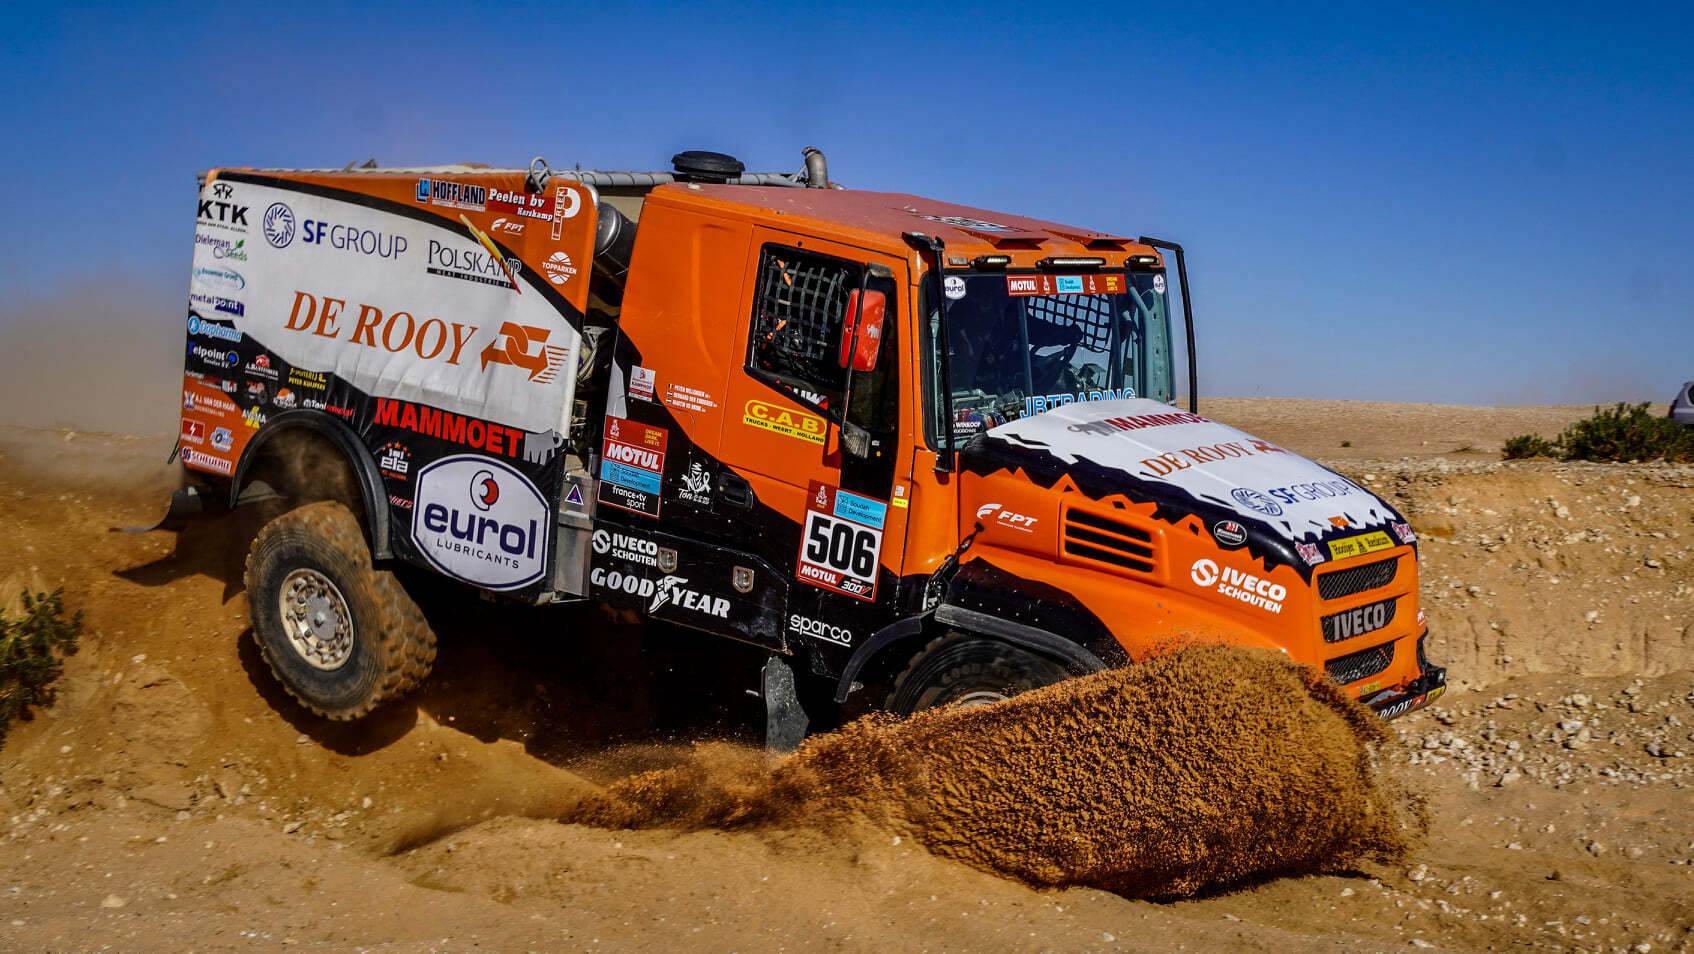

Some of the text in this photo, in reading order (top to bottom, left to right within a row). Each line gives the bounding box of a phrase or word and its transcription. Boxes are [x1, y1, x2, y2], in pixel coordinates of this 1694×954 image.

[432, 180, 486, 205] HOFFLAND
[488, 188, 525, 205] Peelen
[530, 194, 545, 208] bv
[198, 199, 249, 226] KTK
[504, 222, 525, 232] FPT
[542, 260, 577, 275] TOPPARKEN
[1010, 280, 1037, 291] MOTUL
[284, 291, 478, 366] DE ROOY
[374, 397, 524, 458] MAMMOET
[745, 417, 825, 443] TRUCKS WEERT HOLLAND
[606, 442, 660, 470] MOTUL
[1139, 441, 1255, 477] DE ROOY
[626, 498, 646, 510] sport
[848, 508, 882, 523] Development
[849, 500, 870, 511] Soudah
[998, 510, 1039, 527] FPT
[424, 503, 537, 560] eurol
[437, 538, 520, 569] LUBRICANTS
[612, 533, 658, 556] IVECO
[807, 515, 876, 578] 506
[611, 548, 657, 567] SCHOUTEN
[801, 565, 837, 584] MOTUL
[1221, 566, 1287, 602] IVECO
[841, 580, 872, 595] 300V
[1217, 583, 1282, 614] SCHOUTEN
[789, 613, 852, 644] sparco
[1333, 603, 1386, 641] IVECO
